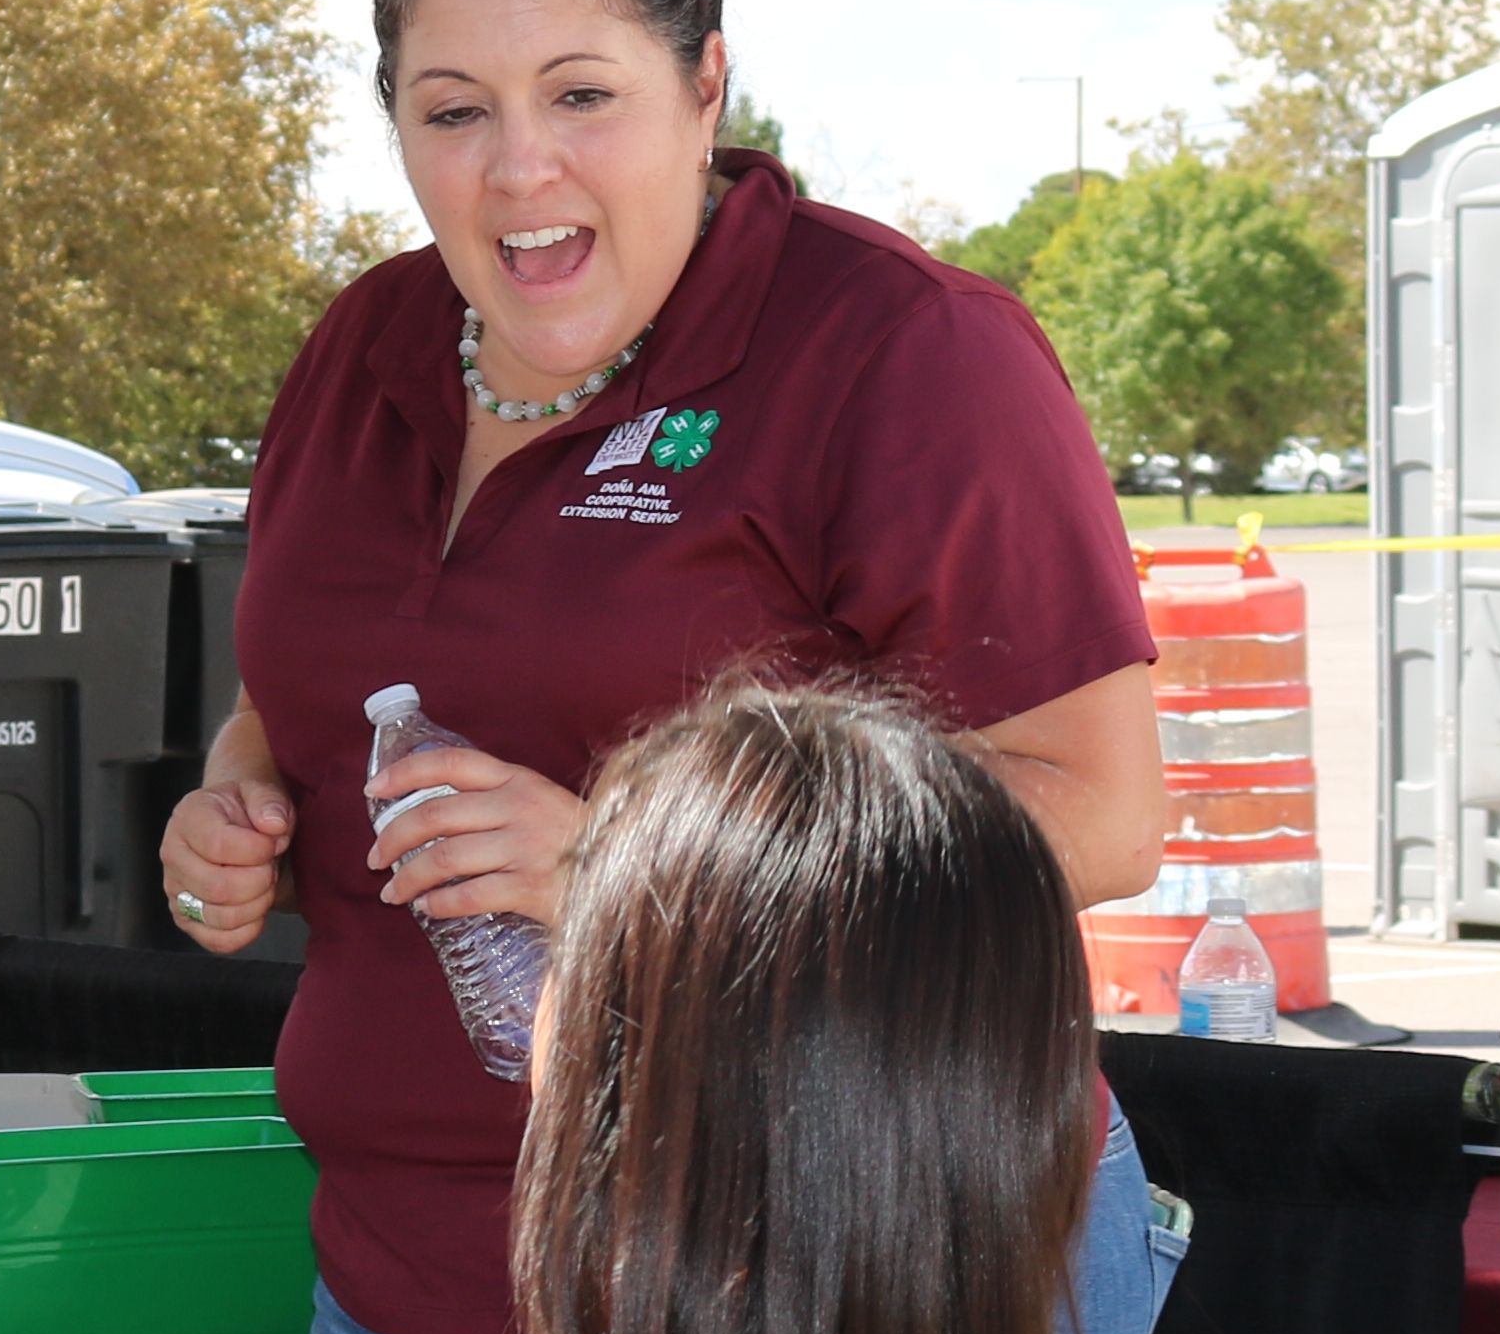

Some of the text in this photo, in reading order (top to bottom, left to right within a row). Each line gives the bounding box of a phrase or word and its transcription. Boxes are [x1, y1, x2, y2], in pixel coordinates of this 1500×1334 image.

[599, 478, 667, 497] DOÑA ANA
[585, 494, 672, 511] COOPERATIVE
[559, 505, 682, 525] EXTENSION SERVIC
